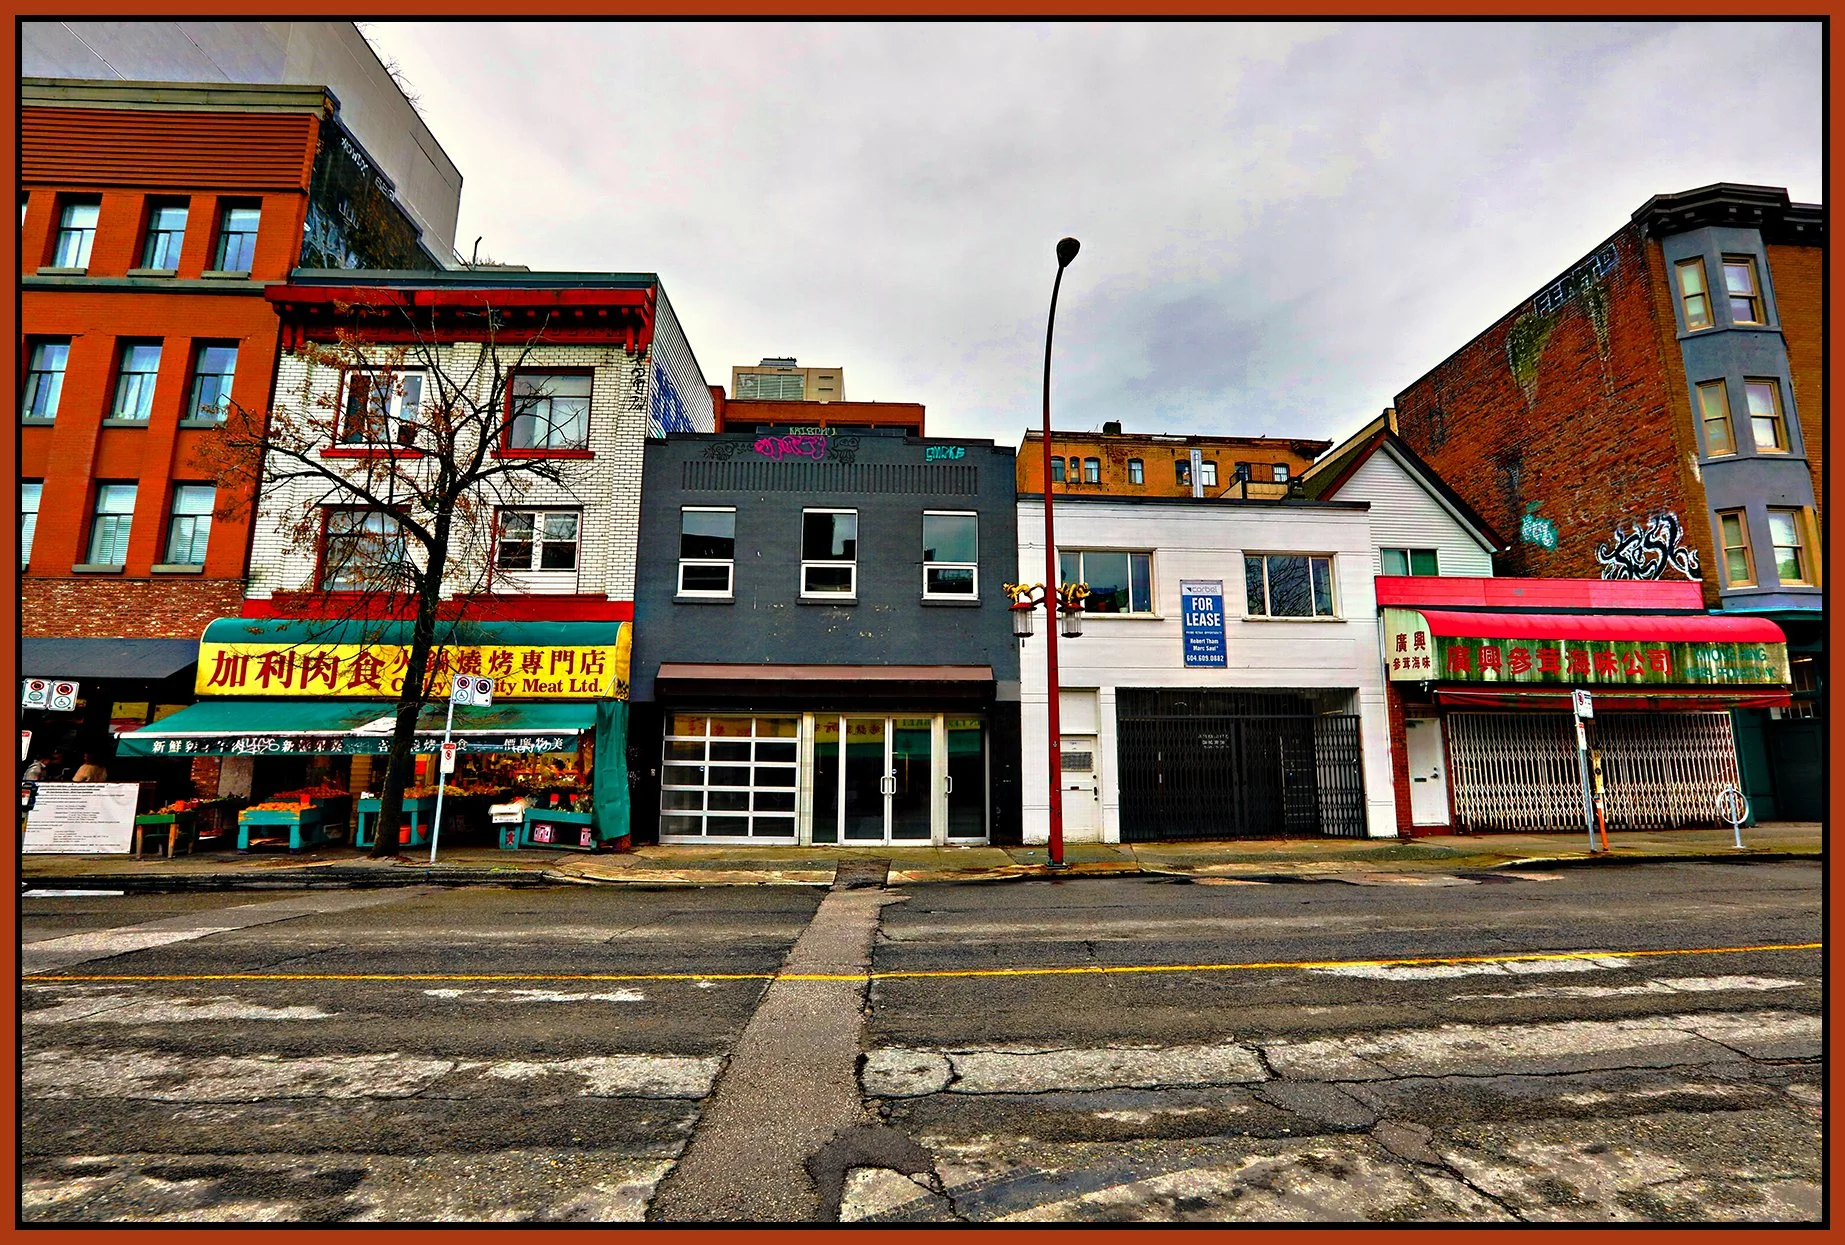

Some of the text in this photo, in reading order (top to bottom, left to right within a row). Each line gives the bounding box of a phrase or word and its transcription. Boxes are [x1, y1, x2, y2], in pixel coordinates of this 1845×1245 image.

[1191, 597, 1214, 611] FOR
[1186, 612, 1221, 627] LEASE
[1694, 647, 1767, 662] KWONG HING
[206, 650, 387, 690] 加利肉食
[390, 677, 447, 696] Cley
[522, 678, 564, 693] Meat
[568, 678, 603, 693] Ltd.
